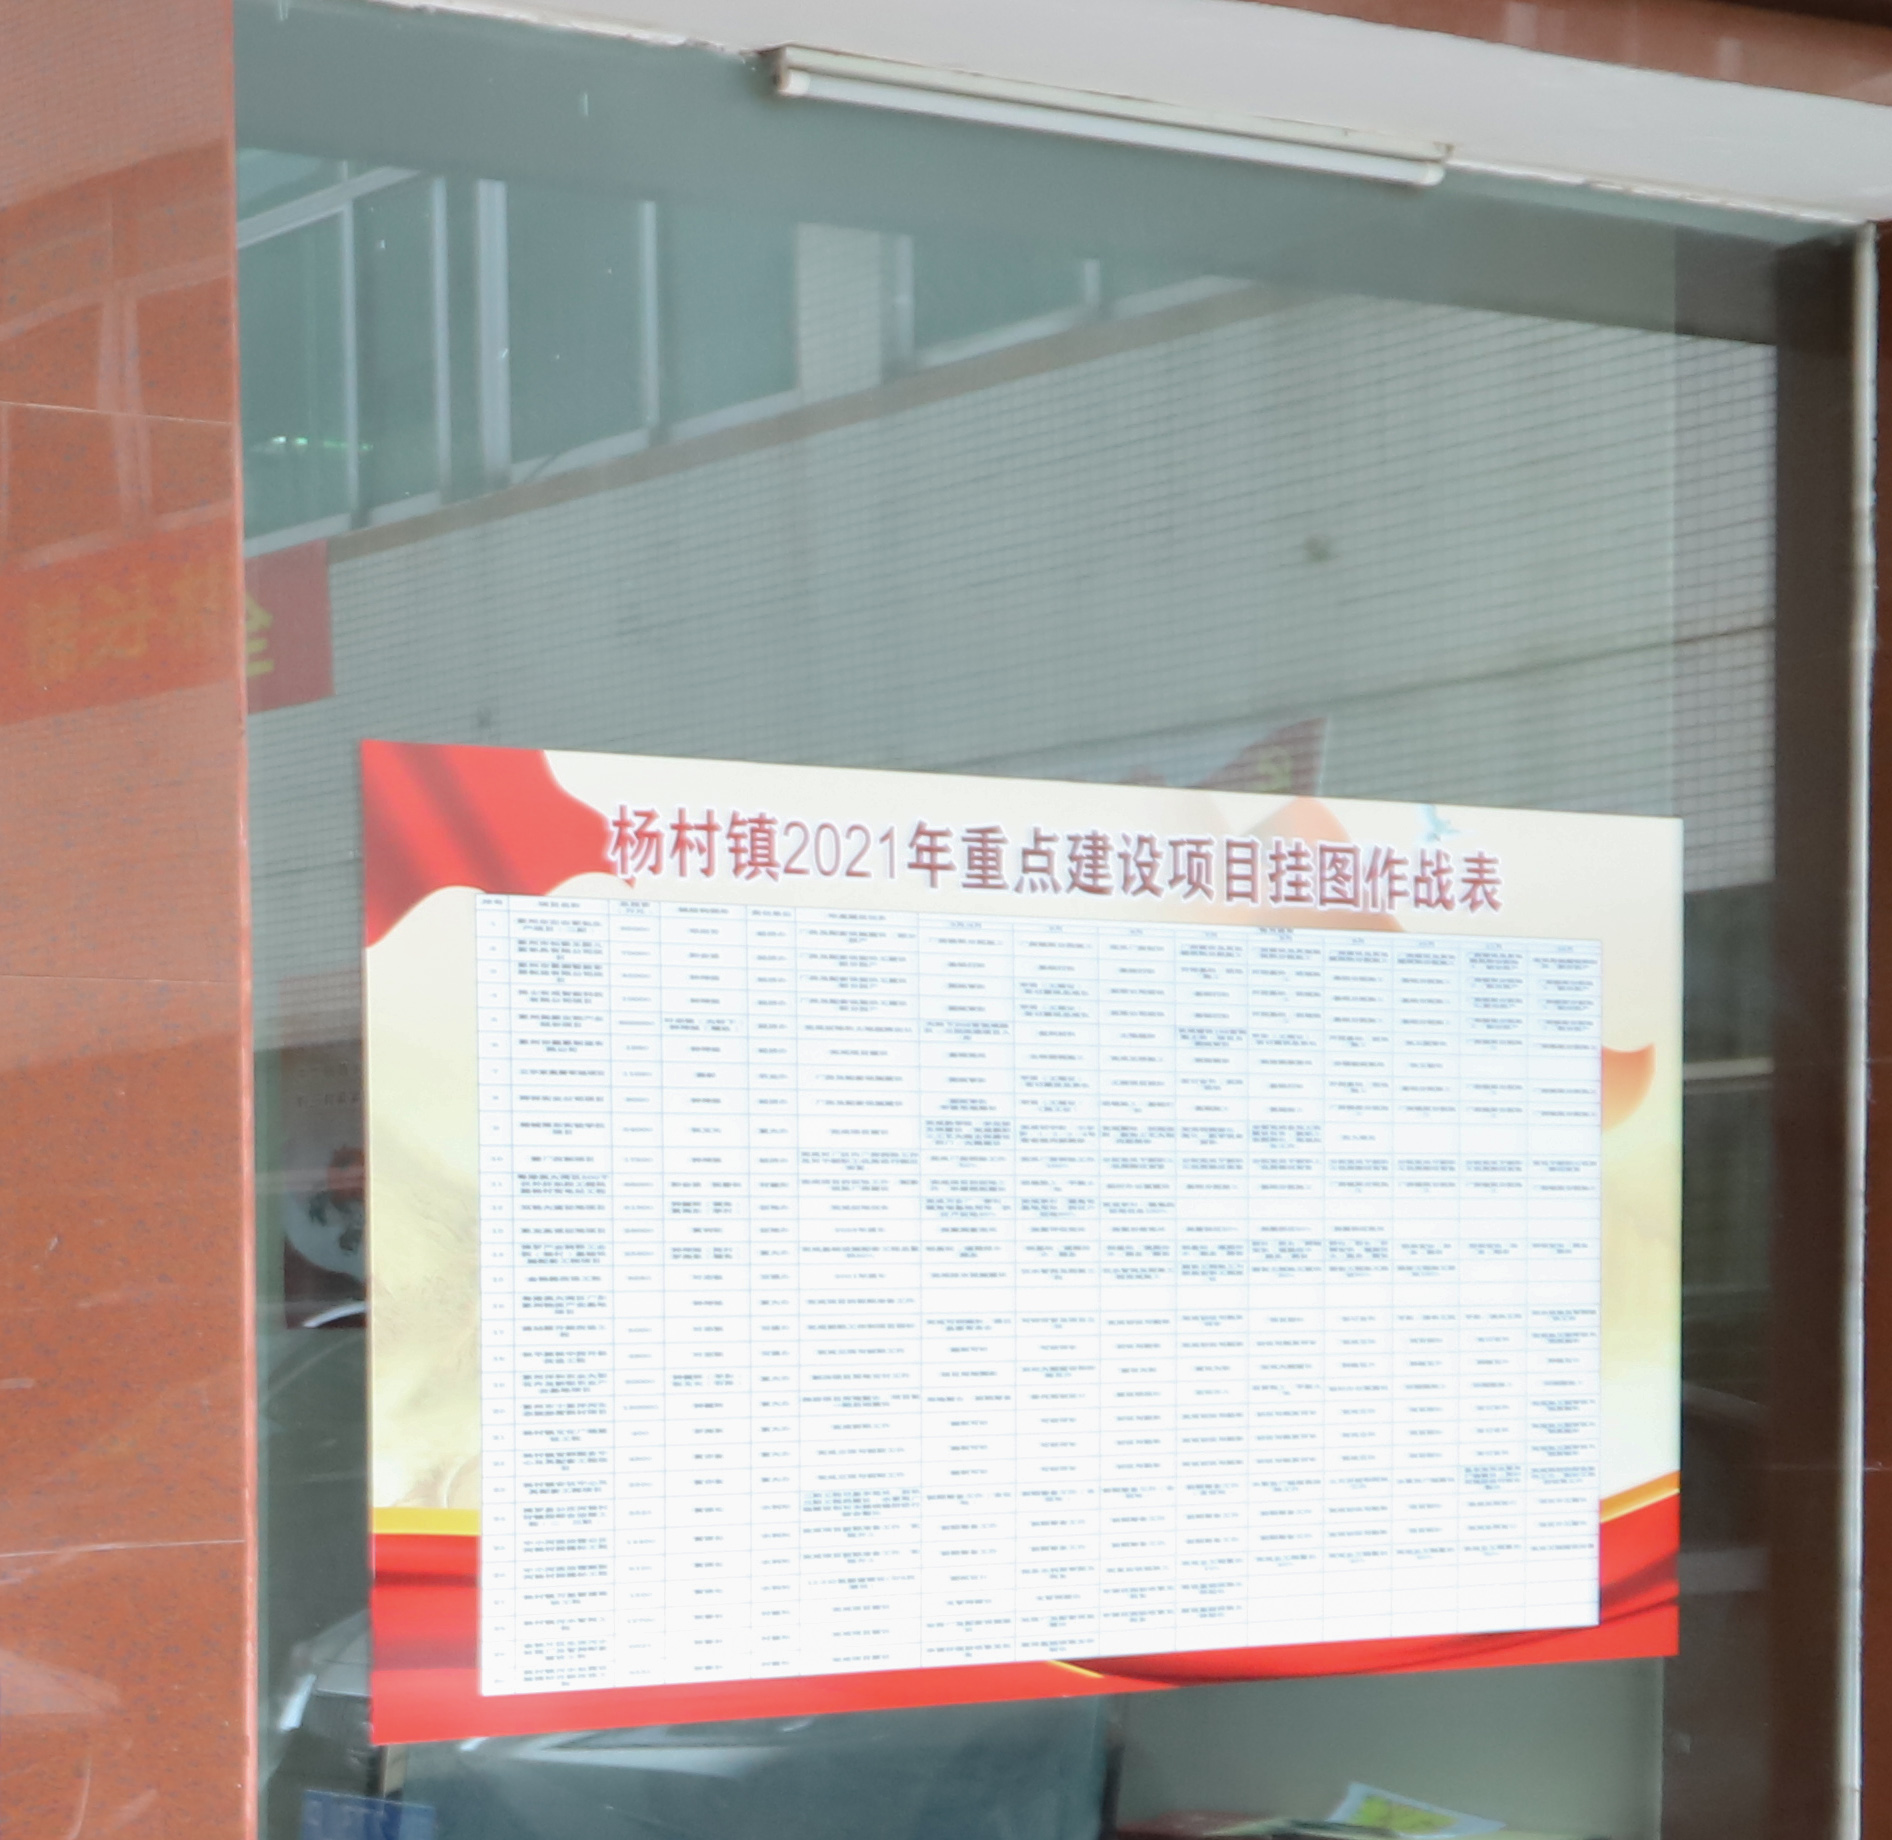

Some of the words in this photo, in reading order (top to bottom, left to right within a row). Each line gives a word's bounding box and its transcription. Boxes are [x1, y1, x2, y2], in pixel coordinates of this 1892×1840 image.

[612, 805, 1503, 912] 杨村镇2021年重点建设项目挂图作战表
